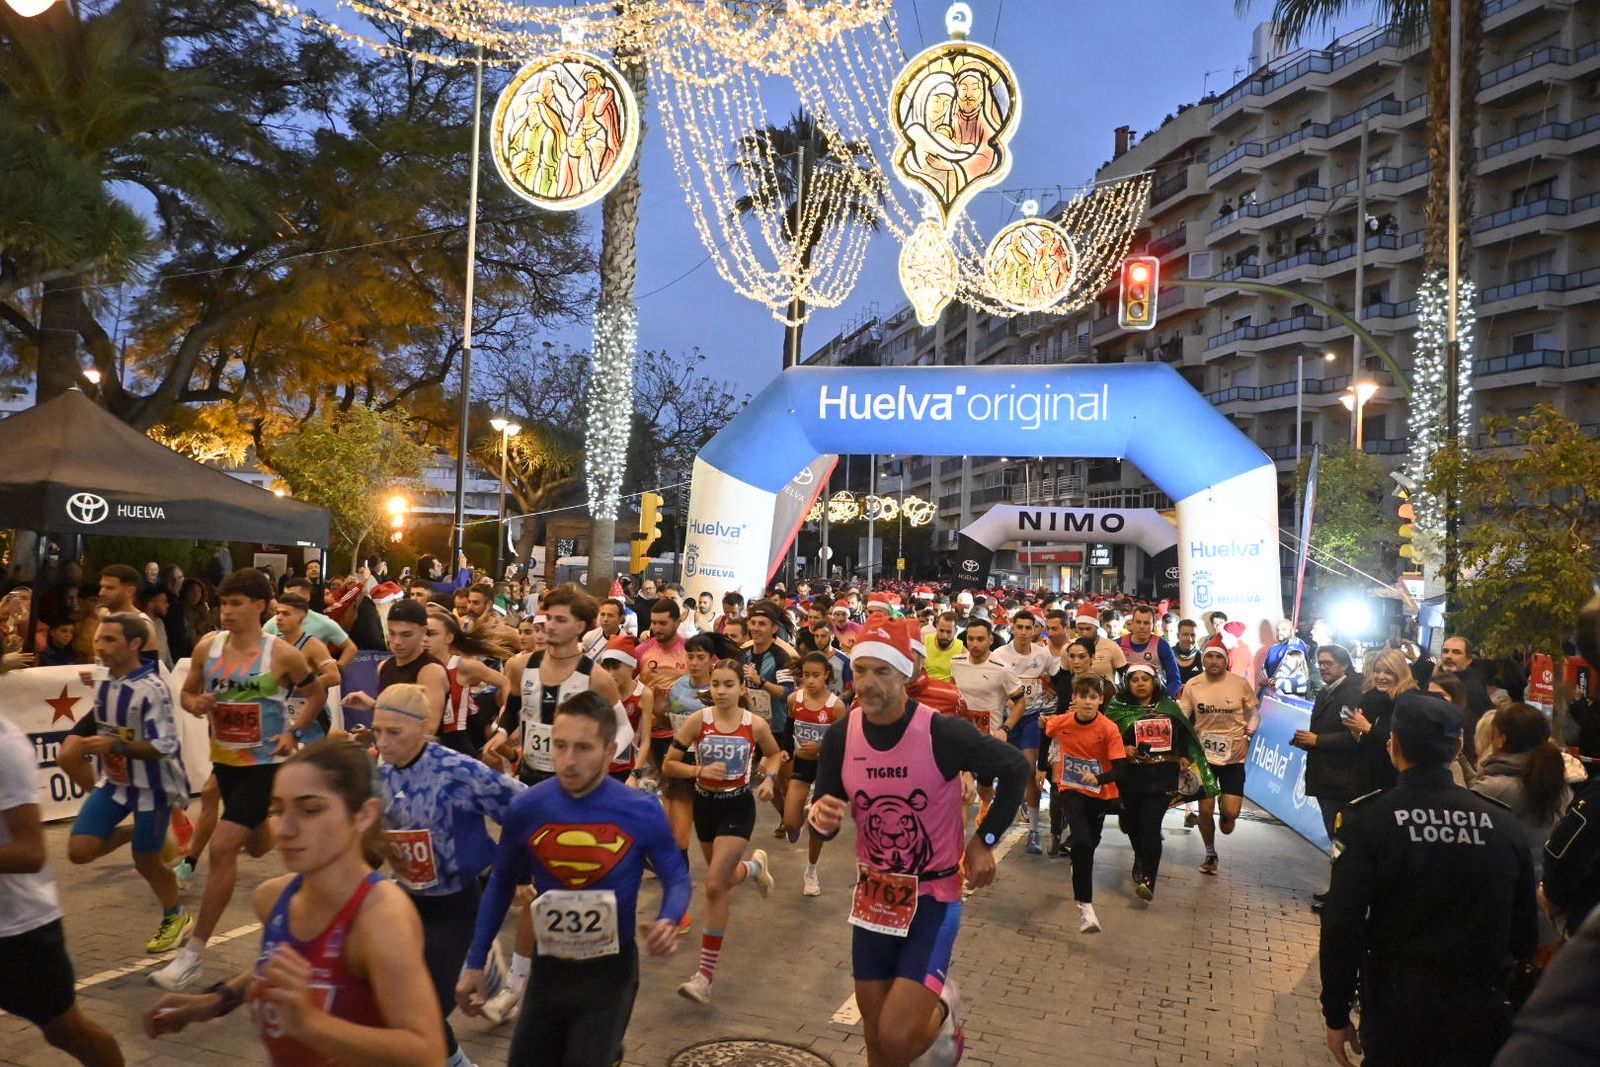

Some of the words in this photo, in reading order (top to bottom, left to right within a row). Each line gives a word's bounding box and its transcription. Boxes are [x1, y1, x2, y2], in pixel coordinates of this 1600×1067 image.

[819, 385, 953, 421] Huelva
[966, 384, 1109, 430] original
[117, 504, 166, 520] HUELVA
[1018, 511, 1125, 533] NIMO
[689, 519, 741, 539] Huelva
[1190, 540, 1261, 559] Huelva
[699, 566, 735, 579] HUELVA
[701, 743, 746, 761] 2591
[1204, 739, 1226, 752] 512
[1251, 734, 1289, 780] Huelva
[866, 766, 908, 779] TIGRES
[1394, 808, 1494, 830] POLICIA
[1408, 826, 1487, 846] LOCAL
[546, 908, 603, 934] 232
